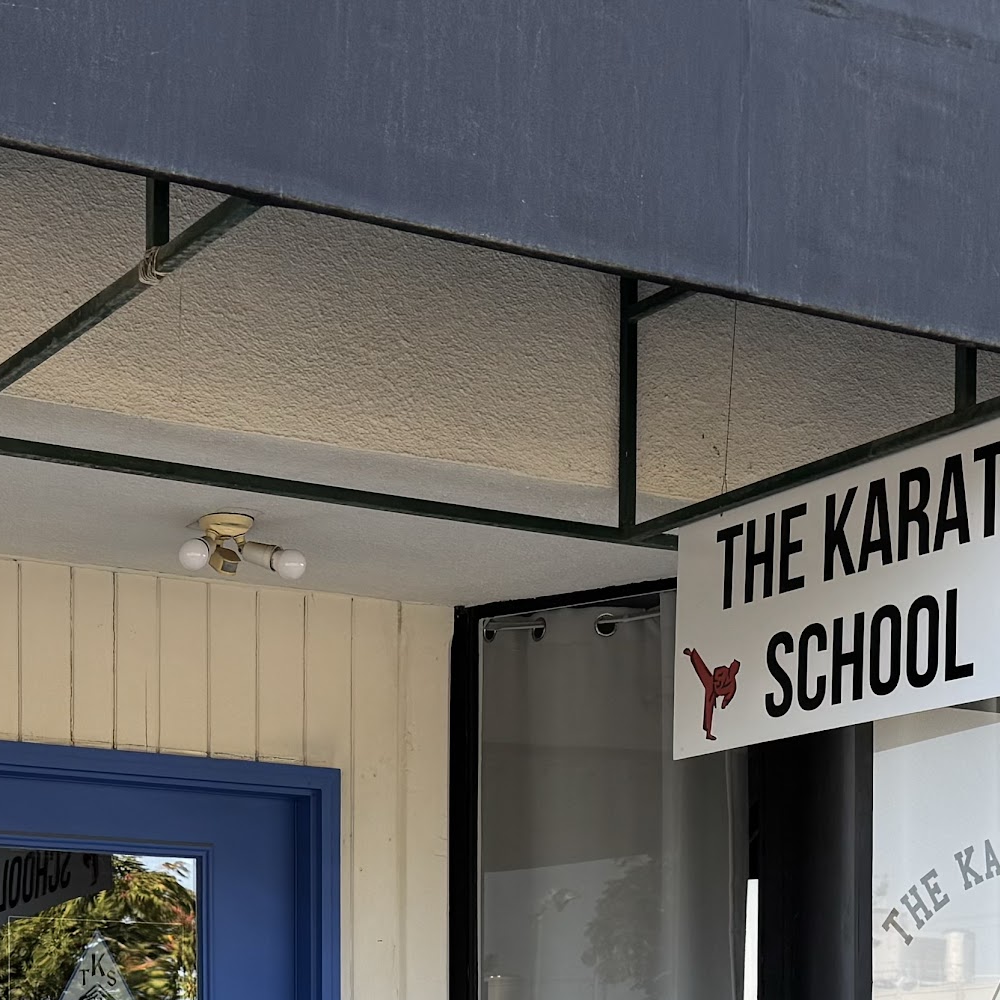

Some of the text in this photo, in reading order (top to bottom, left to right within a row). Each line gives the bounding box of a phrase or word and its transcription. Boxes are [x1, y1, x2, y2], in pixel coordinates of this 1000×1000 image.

[717, 441, 1000, 610] THE KARAT
[765, 588, 974, 718] SCHOOL
[882, 868, 950, 946] THE
[79, 953, 117, 986] TKS
